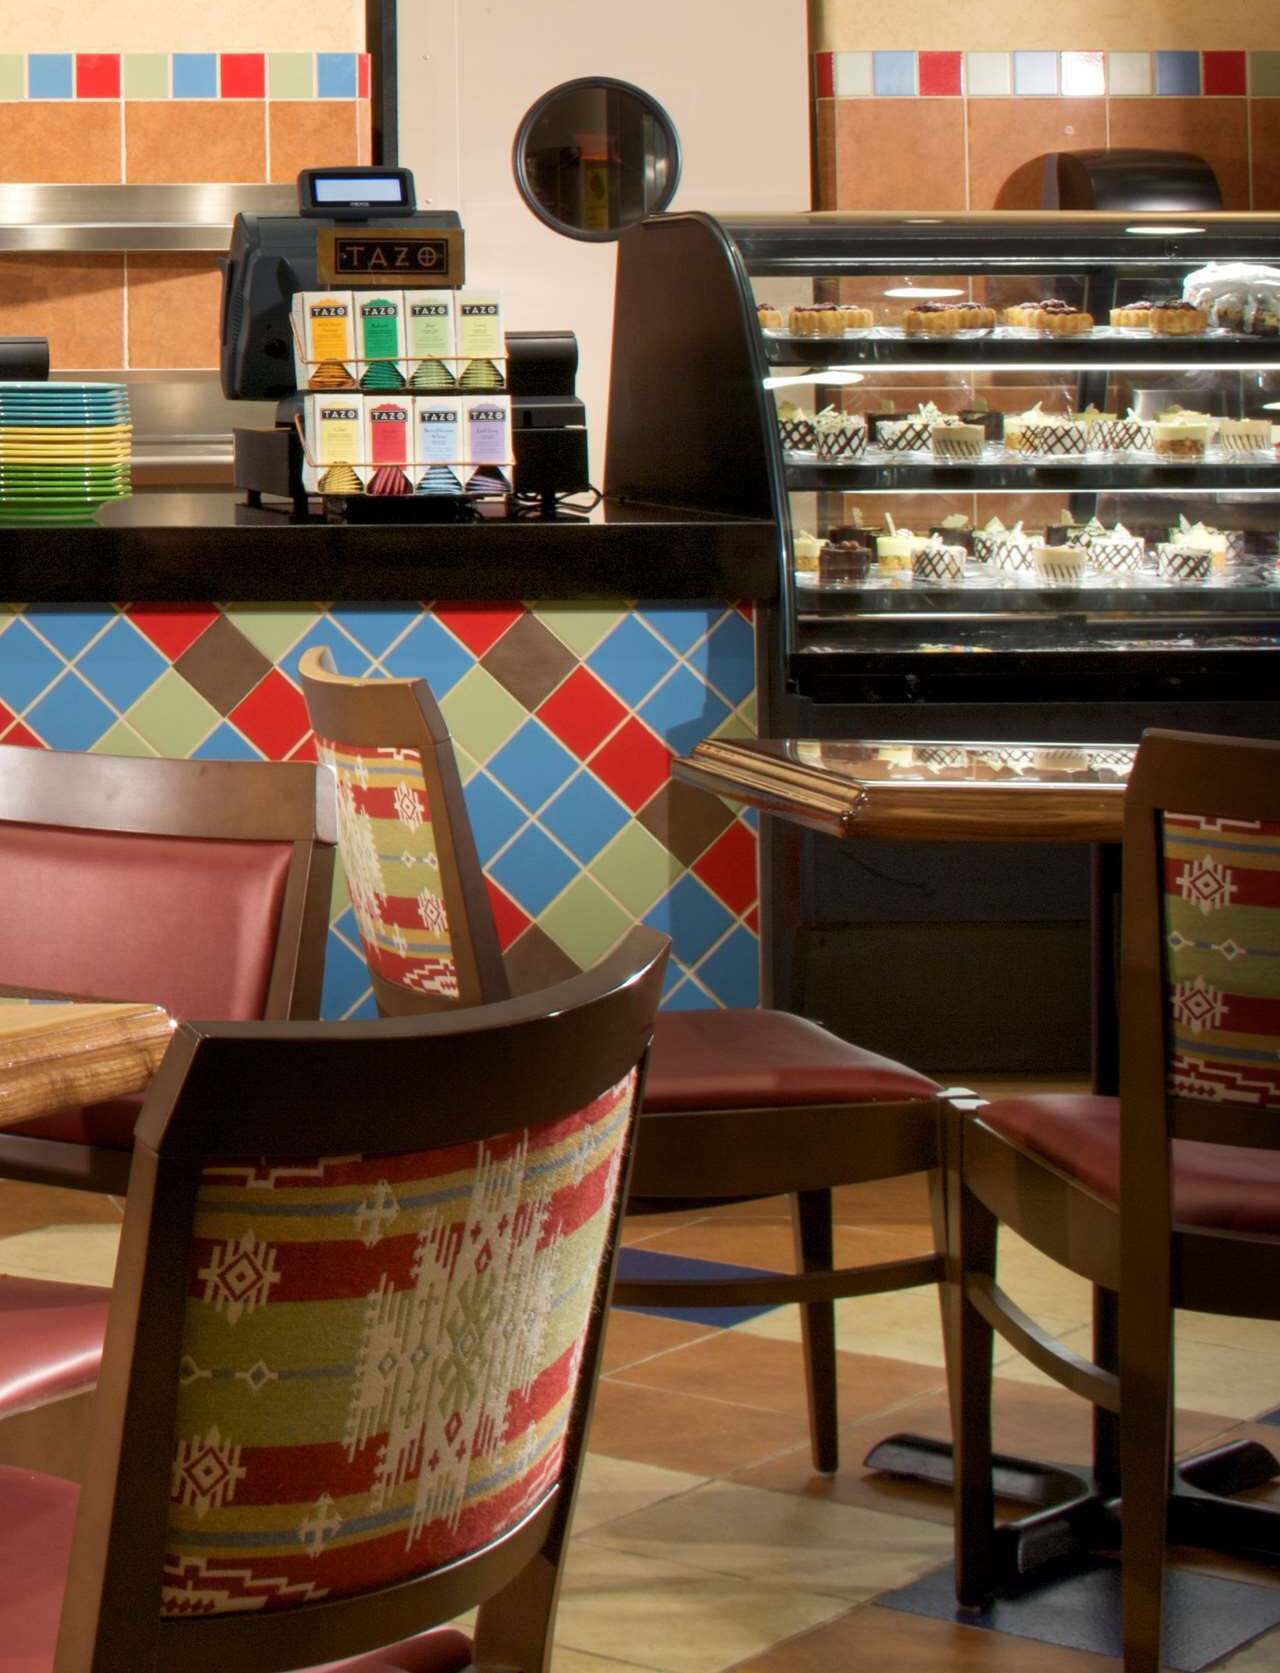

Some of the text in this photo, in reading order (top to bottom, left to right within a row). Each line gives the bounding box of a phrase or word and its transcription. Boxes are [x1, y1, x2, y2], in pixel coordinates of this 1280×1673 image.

[345, 247, 438, 268] TAZO
[313, 307, 345, 316] TAZO
[364, 306, 396, 316] TAZO
[413, 306, 446, 315] TAZO
[463, 305, 497, 314] TAZO
[323, 410, 356, 418] TAZO
[373, 412, 406, 421] TAZO
[423, 412, 455, 421] TAZO
[471, 411, 503, 420] TAZO
